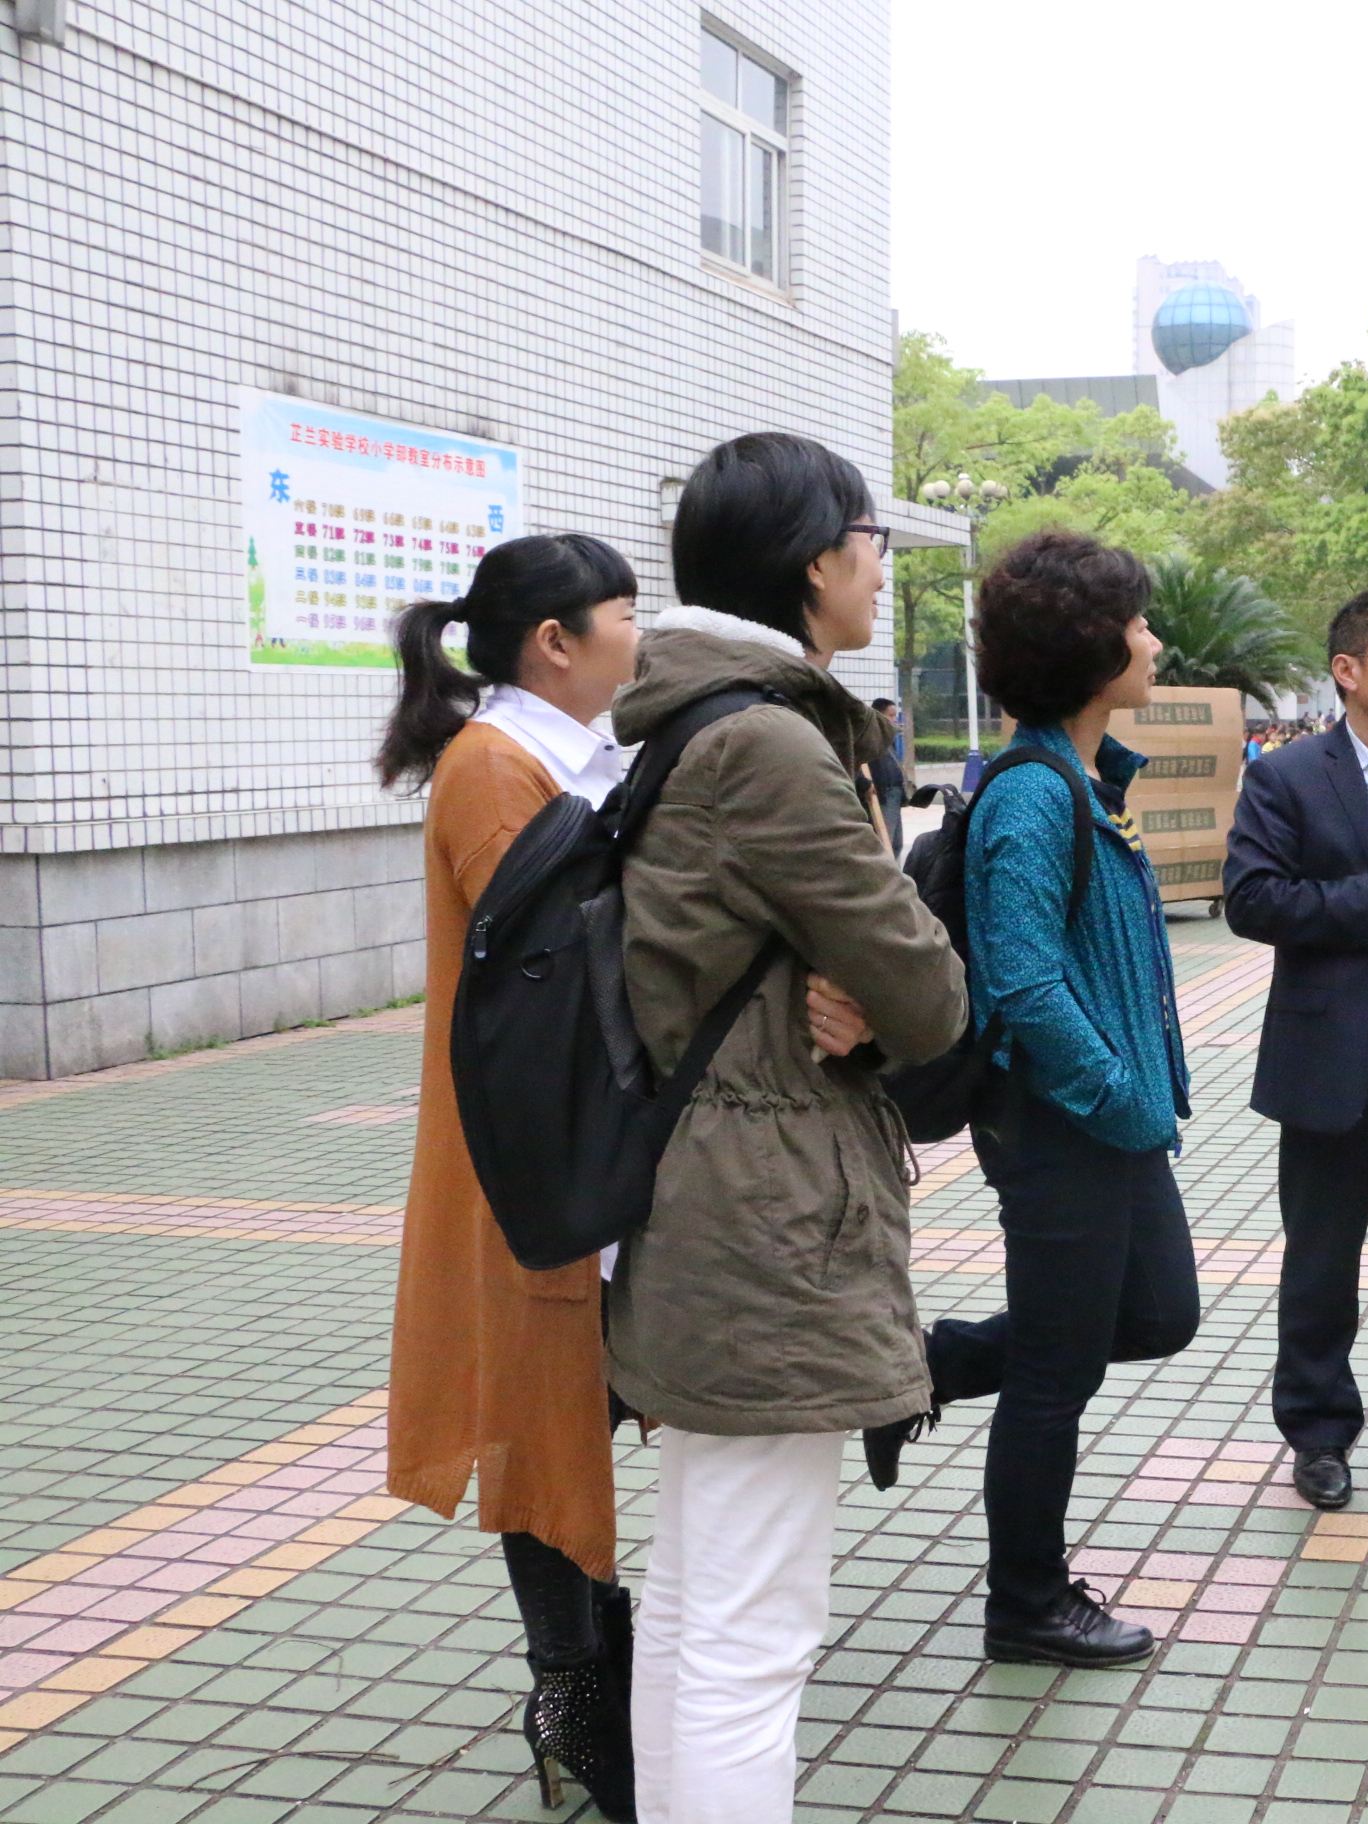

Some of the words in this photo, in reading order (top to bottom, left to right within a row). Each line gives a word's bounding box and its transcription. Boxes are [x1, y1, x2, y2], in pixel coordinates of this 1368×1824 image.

[290, 422, 486, 478] 芷兰实验学校小学部教室分布示意图
[269, 468, 291, 503] 东
[488, 504, 504, 533] 西
[322, 524, 345, 540] 71班
[354, 528, 375, 544] 72班
[383, 533, 404, 548] 73班
[412, 537, 432, 551] 74班
